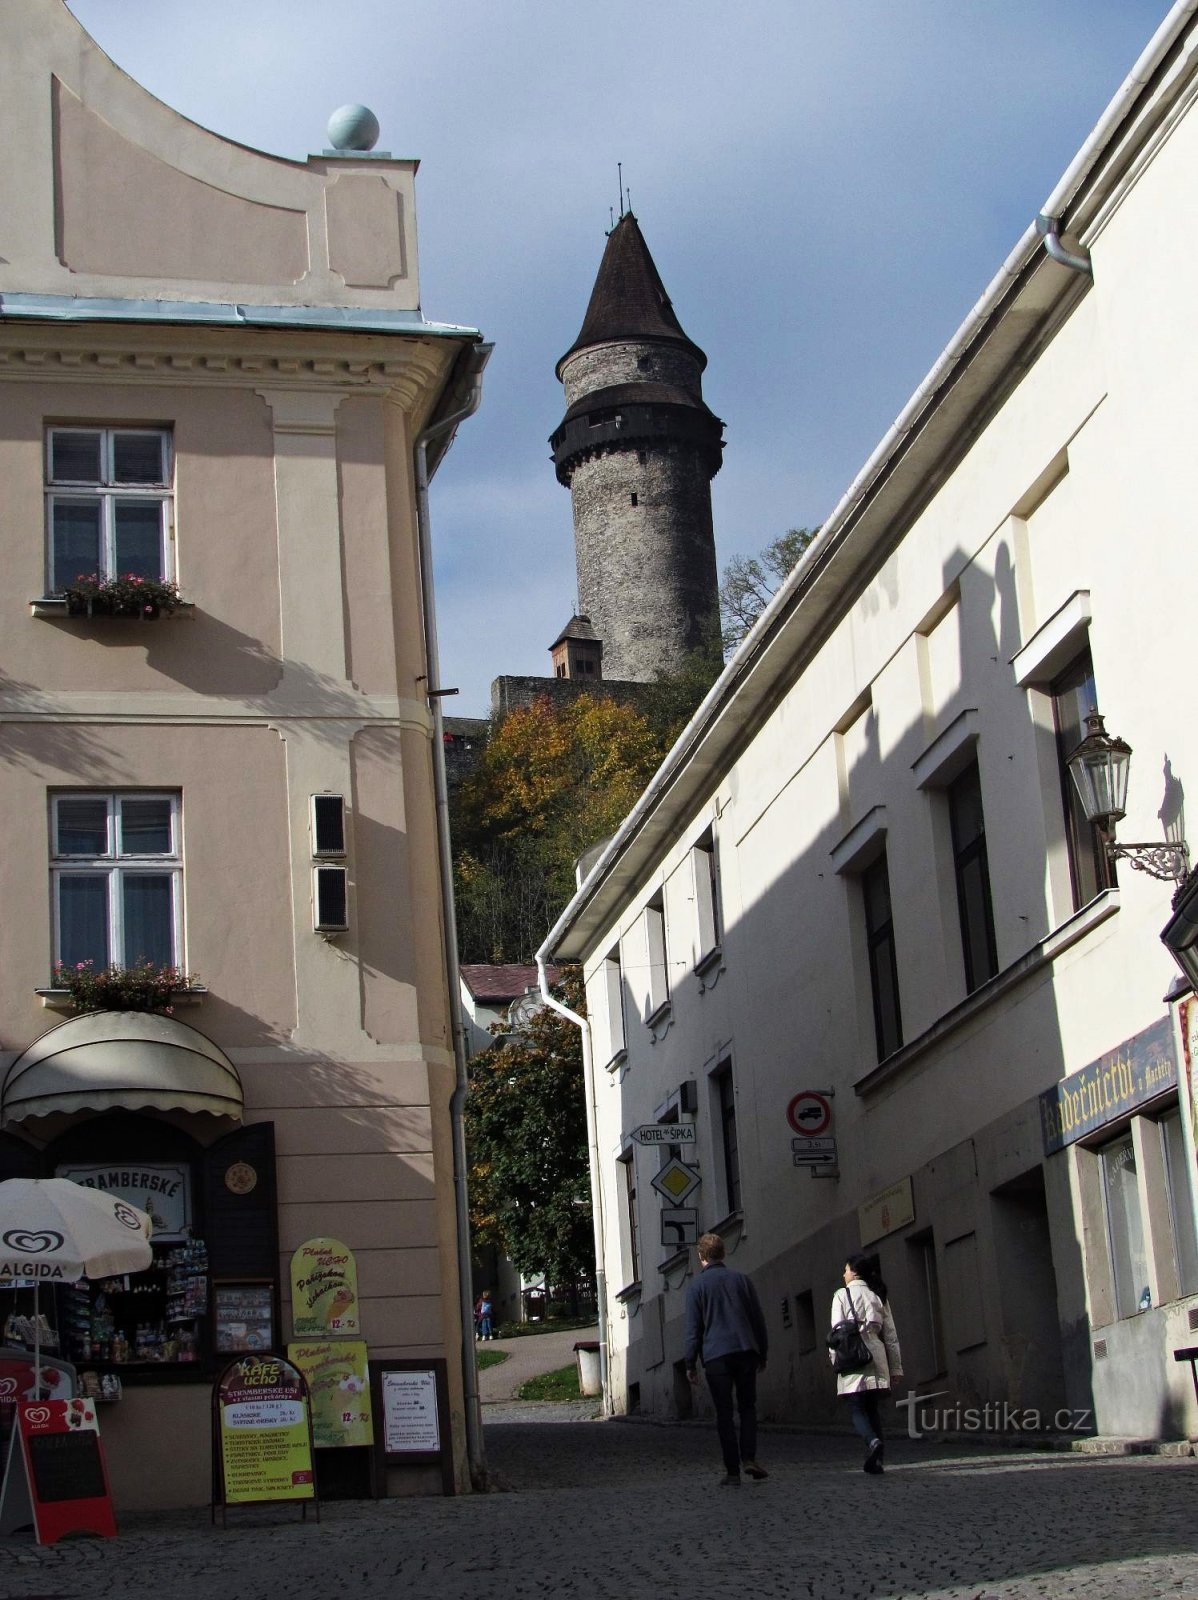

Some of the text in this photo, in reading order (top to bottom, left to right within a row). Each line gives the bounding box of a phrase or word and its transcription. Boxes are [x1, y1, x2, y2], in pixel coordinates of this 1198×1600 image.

[640, 1126, 693, 1141] HOTEL ŠIPKA
[1, 1263, 63, 1277] ALGIDA
[240, 1362, 280, 1377] KAFE
[244, 1373, 277, 1386] ucho
